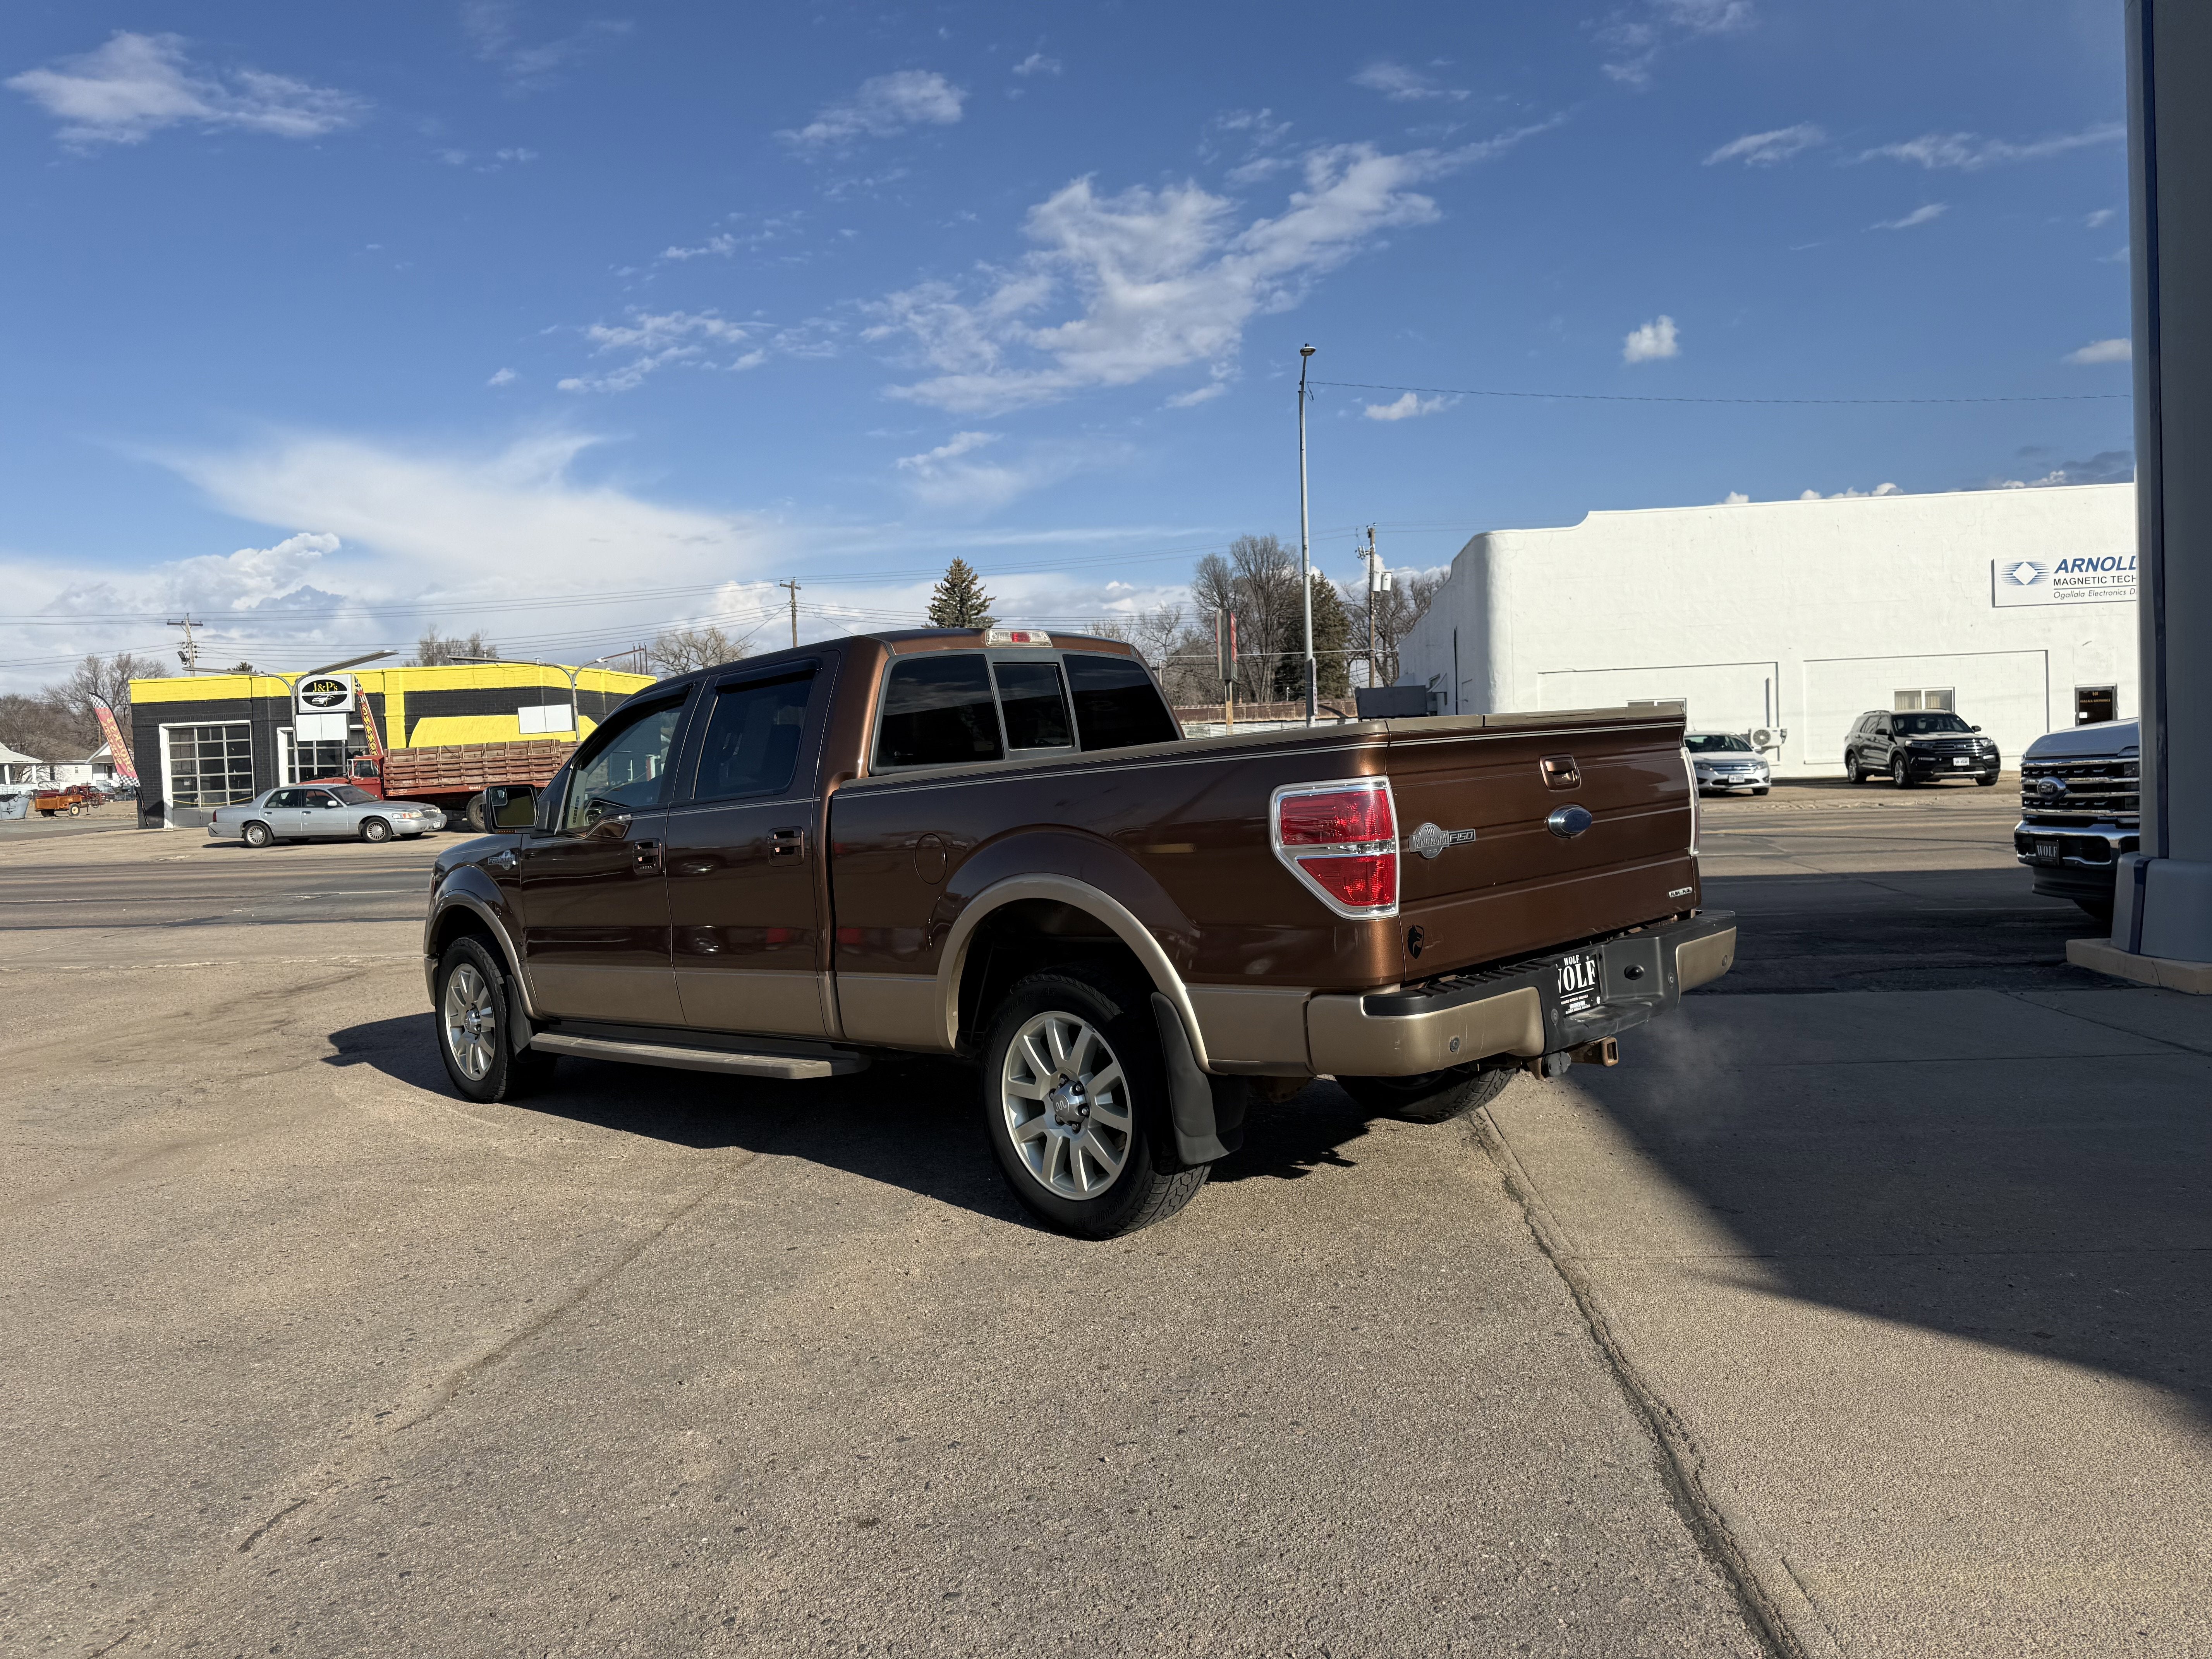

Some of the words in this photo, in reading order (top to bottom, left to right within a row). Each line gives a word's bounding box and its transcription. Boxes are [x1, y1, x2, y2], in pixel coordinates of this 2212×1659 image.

[2054, 576, 2107, 586] MAGNETIC
[2054, 590, 2085, 600] Ogallala
[2088, 589, 2126, 597] Electronics
[313, 682, 338, 692] J&P's
[2037, 845, 2057, 857] WOLF
[1563, 955, 1579, 966] WOLF
